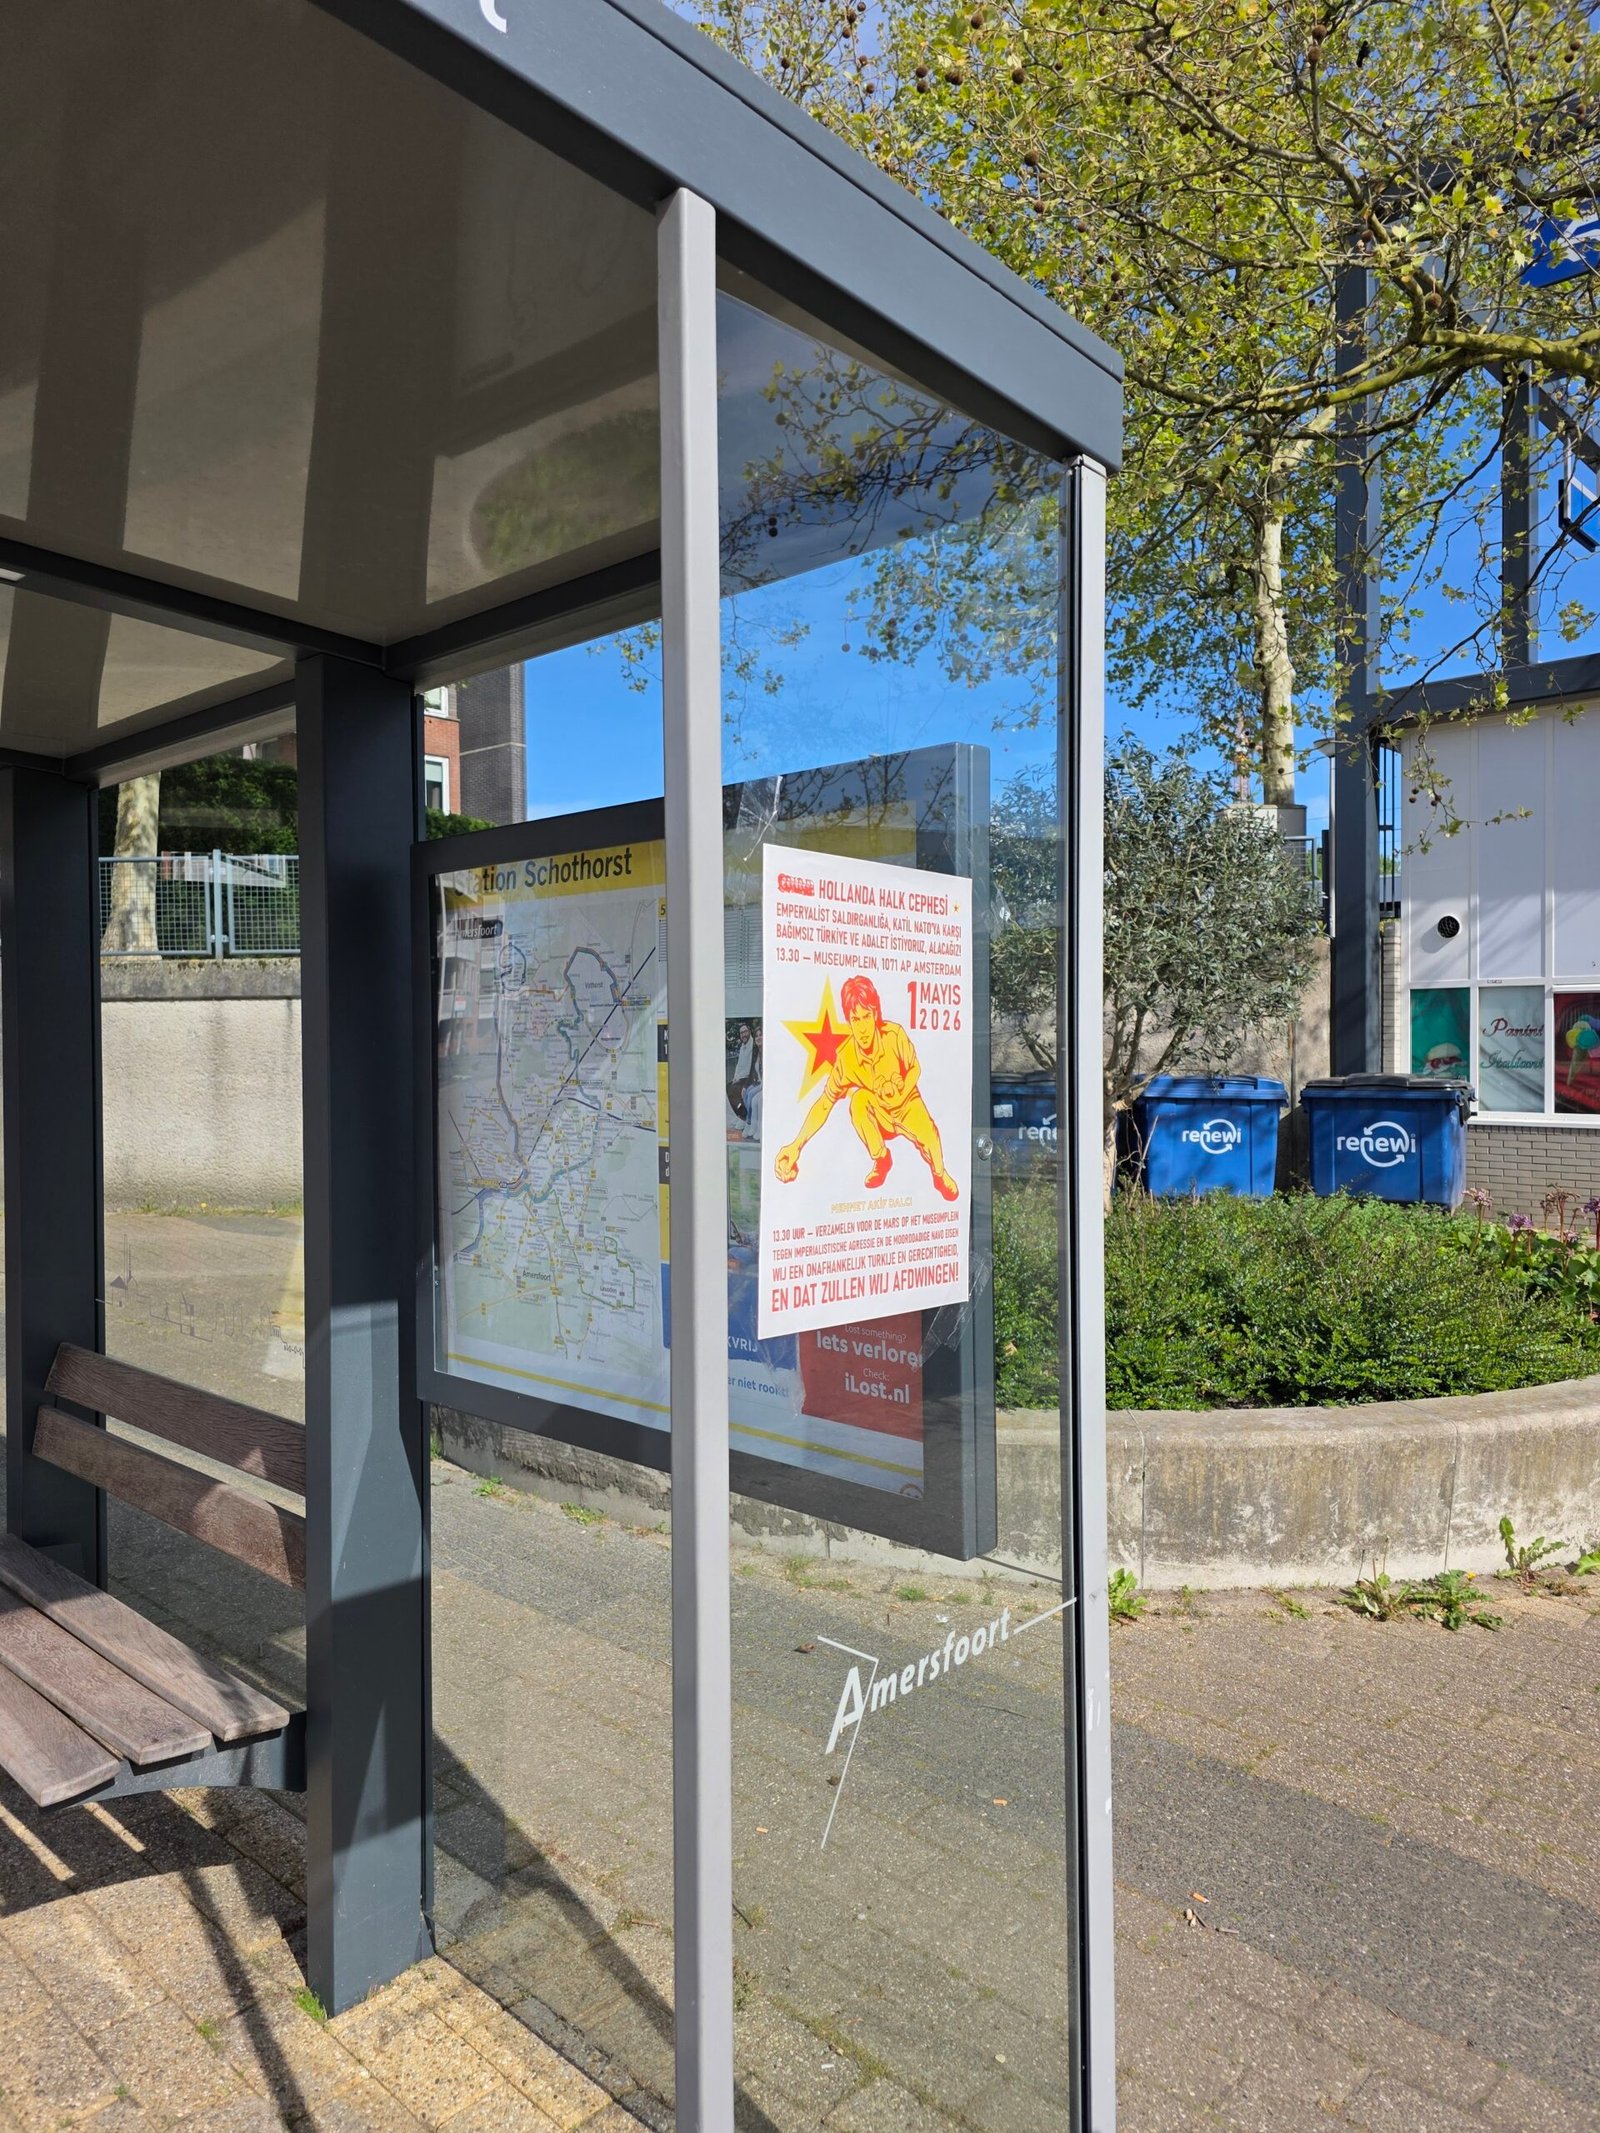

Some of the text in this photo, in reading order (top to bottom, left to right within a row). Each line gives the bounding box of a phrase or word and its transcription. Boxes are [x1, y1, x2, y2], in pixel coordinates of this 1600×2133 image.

[524, 847, 632, 887] Schothorst
[819, 879, 875, 906] HOLLANDA
[880, 889, 905, 910] HALK
[909, 893, 948, 916] CEPHESİ
[456, 924, 497, 938] mersfoort
[777, 902, 830, 922] EMPERYALİST
[893, 916, 911, 932] KATİL
[777, 922, 814, 941] BAĞIMSIZ
[817, 927, 847, 945] TÜRKİYE
[850, 932, 859, 946] VE
[862, 934, 888, 950] ADALET
[776, 947, 799, 962] 13.30
[814, 951, 879, 972] MUSEUMPLEIN,
[882, 958, 898, 971] 1071
[901, 960, 911, 972] AP
[914, 961, 961, 976] AMSTERDAM
[908, 981, 960, 1029] 1 MAYIS
[920, 1008, 961, 1031] 2026
[1482, 1017, 1545, 1037] Panini
[773, 1229, 790, 1242] 13.30
[793, 1227, 805, 1239] UUR
[816, 1222, 854, 1238] VERZAMELEN
[857, 1220, 872, 1232] VOOR
[875, 1219, 882, 1229] DE
[884, 1216, 899, 1229] MARS
[902, 1215, 909, 1227] OP
[911, 1214, 921, 1226] HET
[773, 1248, 792, 1261] TEGEN
[849, 1237, 874, 1251] AGRESSIE
[877, 1236, 883, 1247] EN
[885, 1236, 892, 1246] DE
[773, 1267, 786, 1281] WIJ
[789, 1265, 804, 1280] EEN
[807, 1256, 866, 1276] ONAFHANKELIJK
[898, 1251, 906, 1264] EN
[772, 1262, 959, 1312] EN DAT ZULLEN WIJ AFDWINGEN!
[845, 1324, 906, 1343] Lost something?
[737, 1376, 757, 1391] niet
[845, 1373, 910, 1403] iLost.nl
[863, 1368, 889, 1381] Check:
[825, 1607, 1012, 1755] Amersfoort
